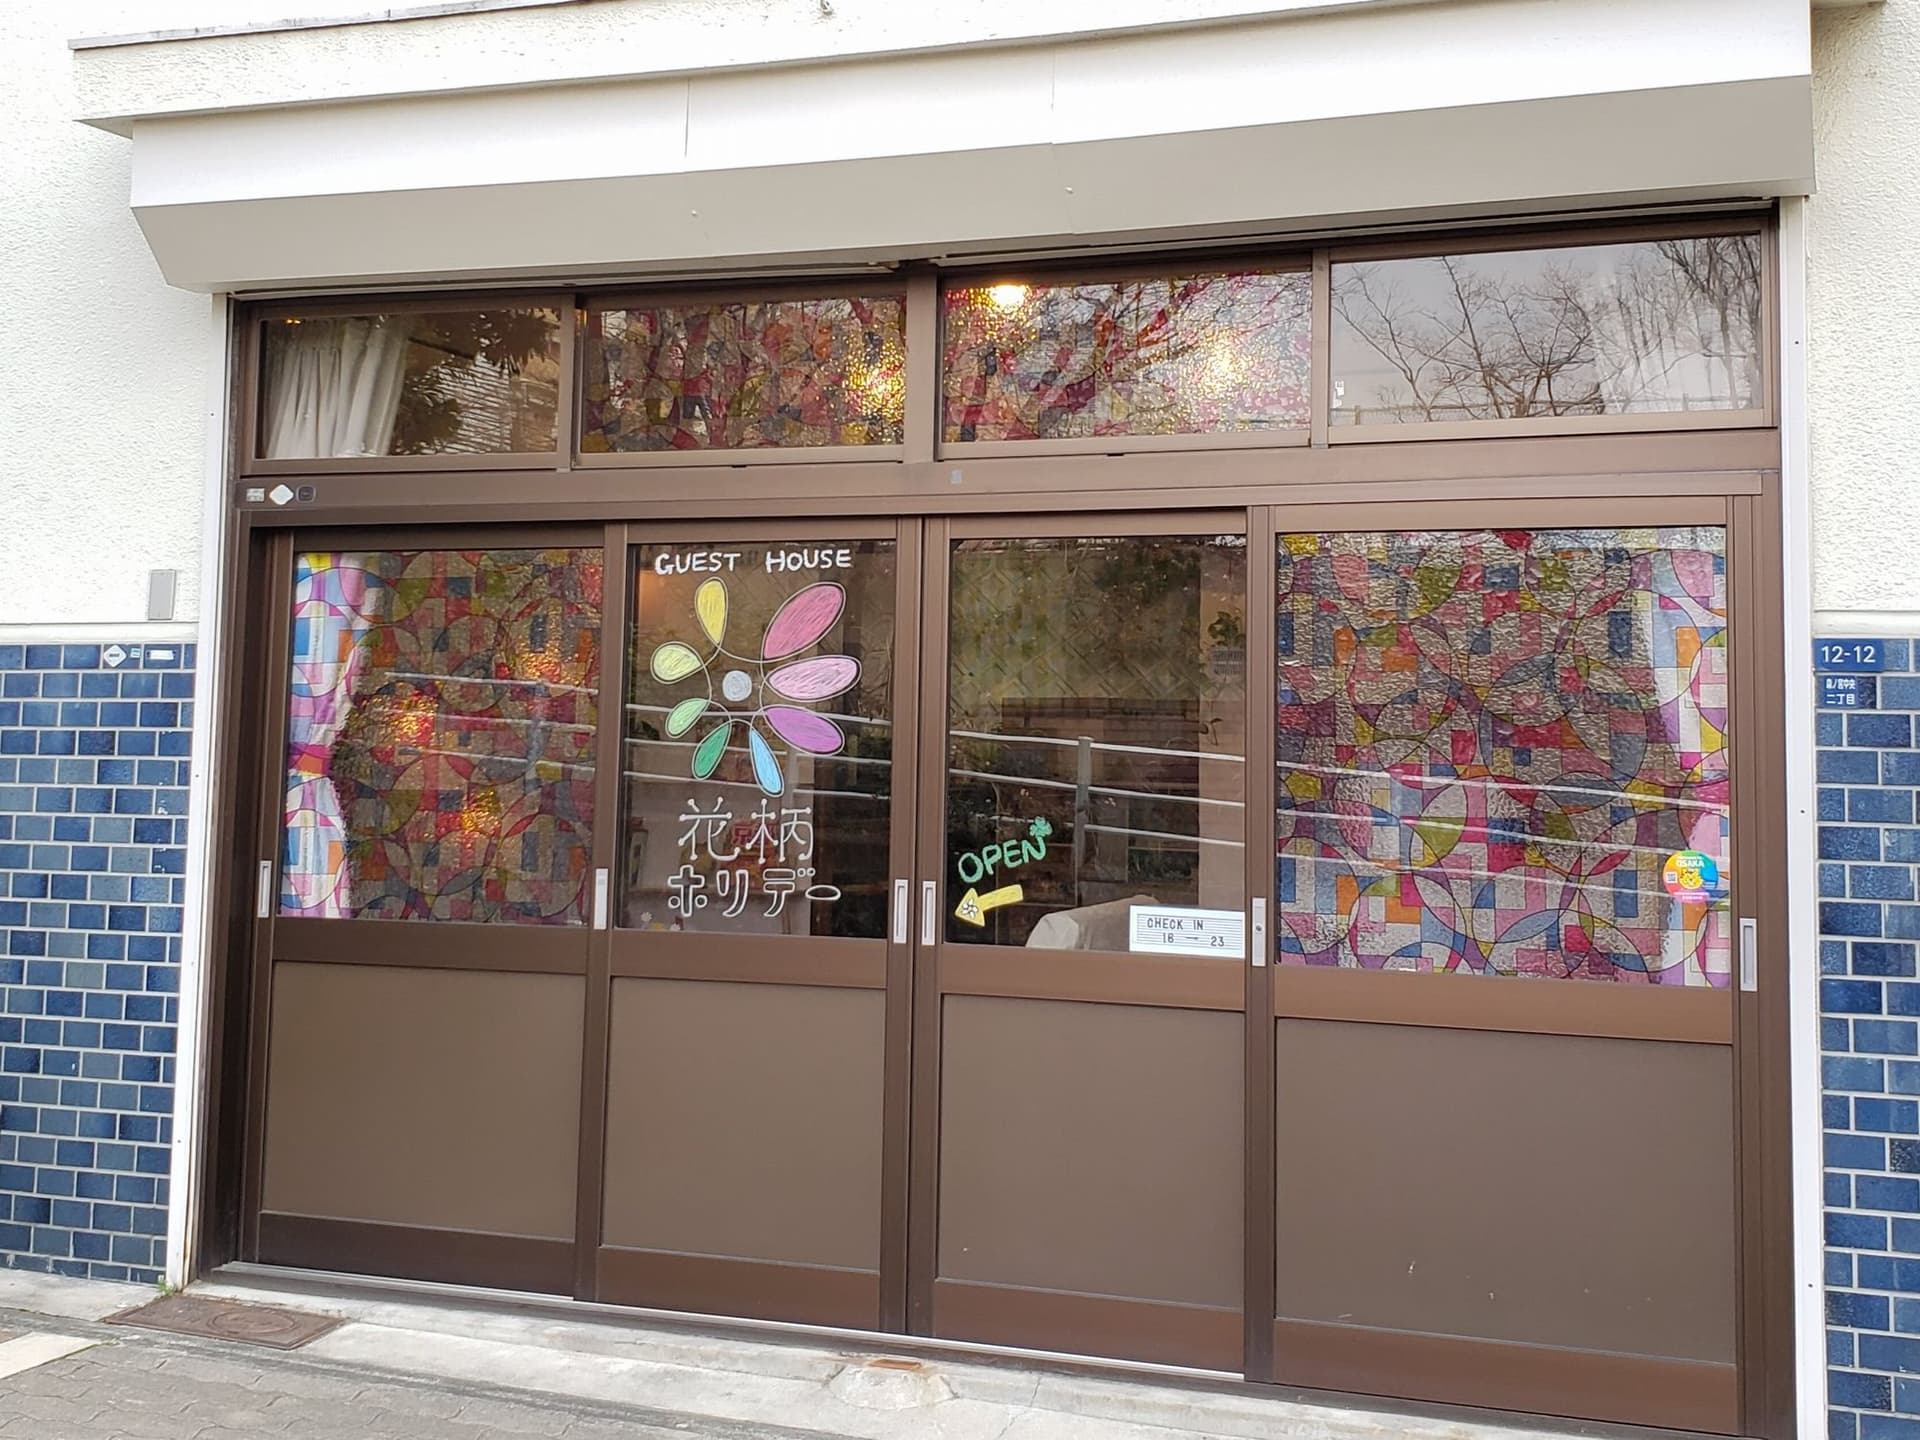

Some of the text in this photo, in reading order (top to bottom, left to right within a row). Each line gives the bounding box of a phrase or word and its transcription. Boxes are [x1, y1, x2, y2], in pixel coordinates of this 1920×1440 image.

[654, 549, 852, 575] GUEST HOUSE
[1821, 645, 1876, 663] 12-12
[1826, 693, 1856, 705] 二丁目
[678, 796, 814, 864] 花柄
[957, 836, 1049, 883] OPEN
[1676, 859, 1705, 868] OSAKA
[667, 864, 842, 918] ホリデー
[1146, 917, 1204, 931] CHECK IN
[1210, 935, 1225, 947] 23
